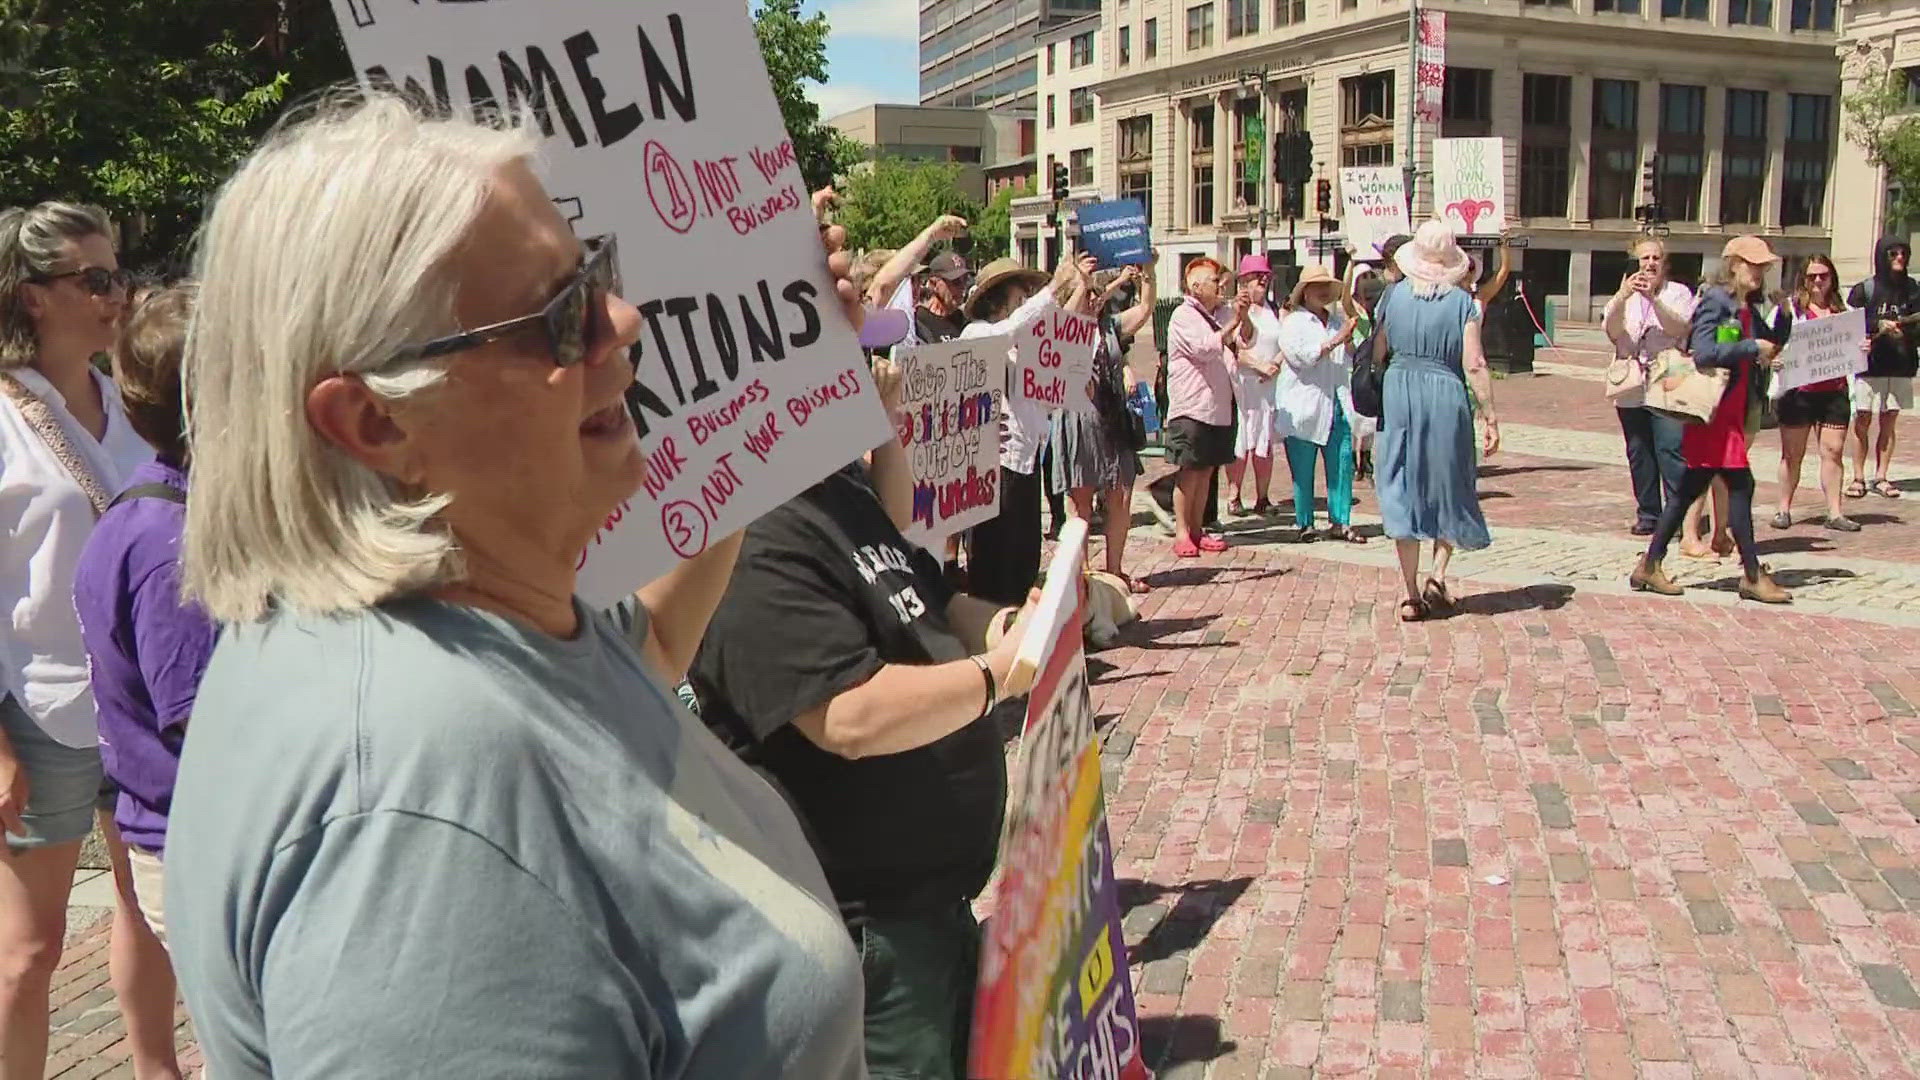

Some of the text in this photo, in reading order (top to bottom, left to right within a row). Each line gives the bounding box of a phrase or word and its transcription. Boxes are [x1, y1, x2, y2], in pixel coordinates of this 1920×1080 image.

[692, 157, 742, 218] NOT
[748, 141, 796, 186] YOUR
[1372, 172, 1379, 181] A
[1456, 168, 1483, 184] OWN
[1360, 183, 1402, 193] WOMAN
[1348, 195, 1383, 205] NOT A
[1362, 206, 1398, 216] WOMB
[1038, 339, 1061, 368] Go
[901, 349, 987, 405] Keep The
[701, 451, 743, 521] NOT
[743, 411, 785, 464] YOUR
